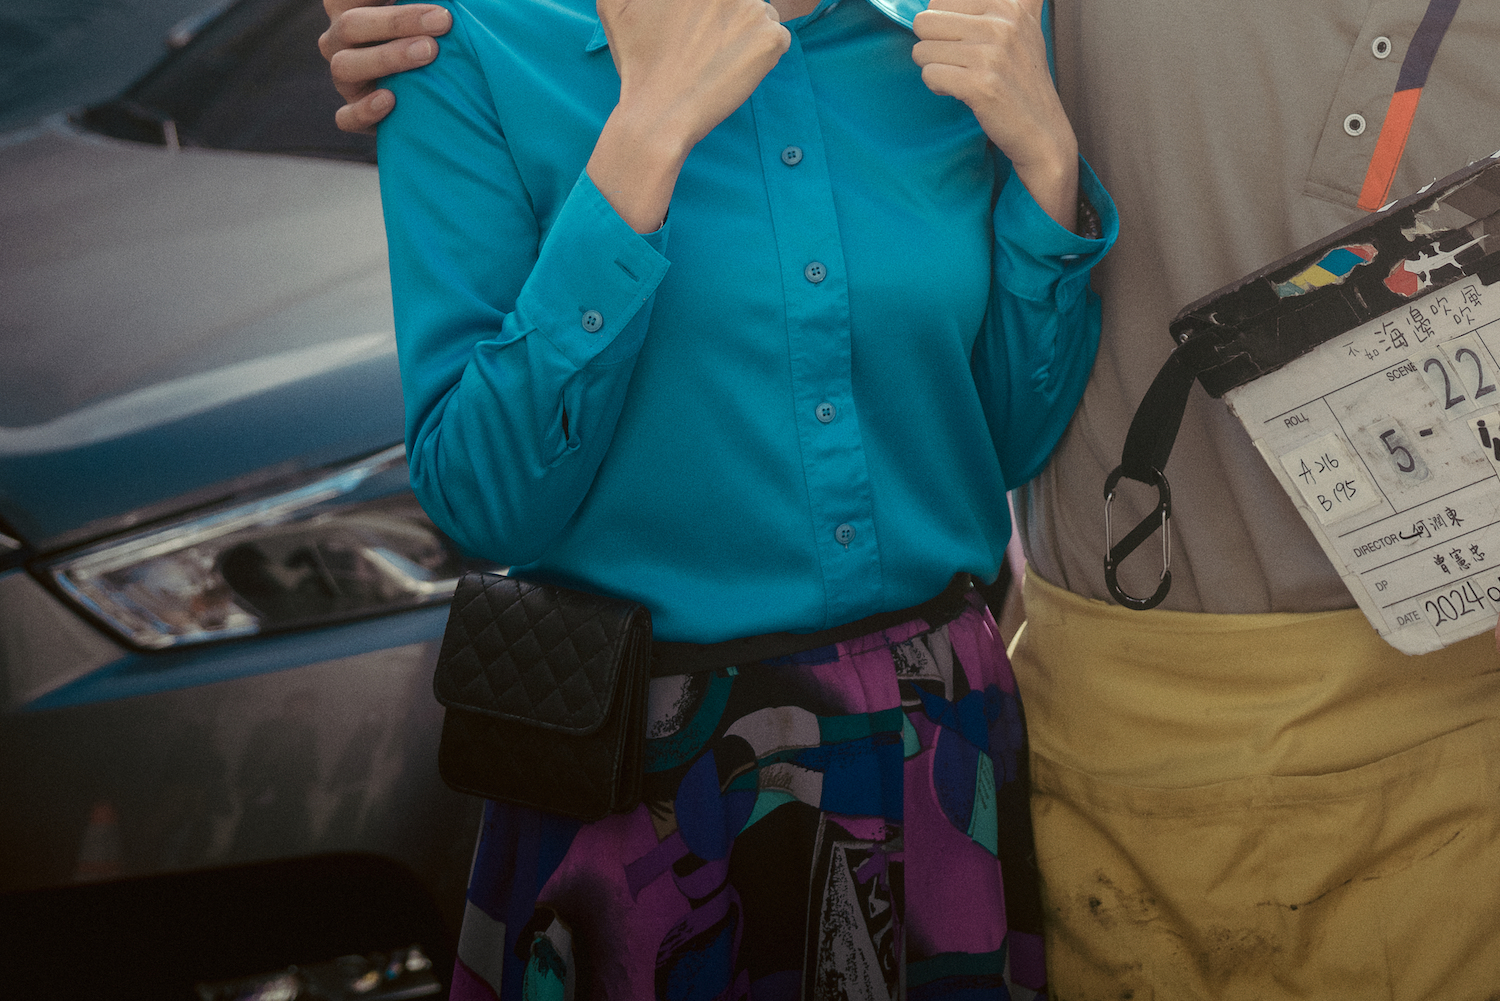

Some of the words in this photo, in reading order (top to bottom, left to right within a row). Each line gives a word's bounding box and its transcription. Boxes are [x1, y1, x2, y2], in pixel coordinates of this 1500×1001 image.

[1386, 361, 1418, 382] SCENE
[1284, 412, 1309, 428] ROLL
[1353, 533, 1400, 558] DIRECTOR
[1374, 579, 1389, 592] DP
[1396, 610, 1421, 626] DATE
